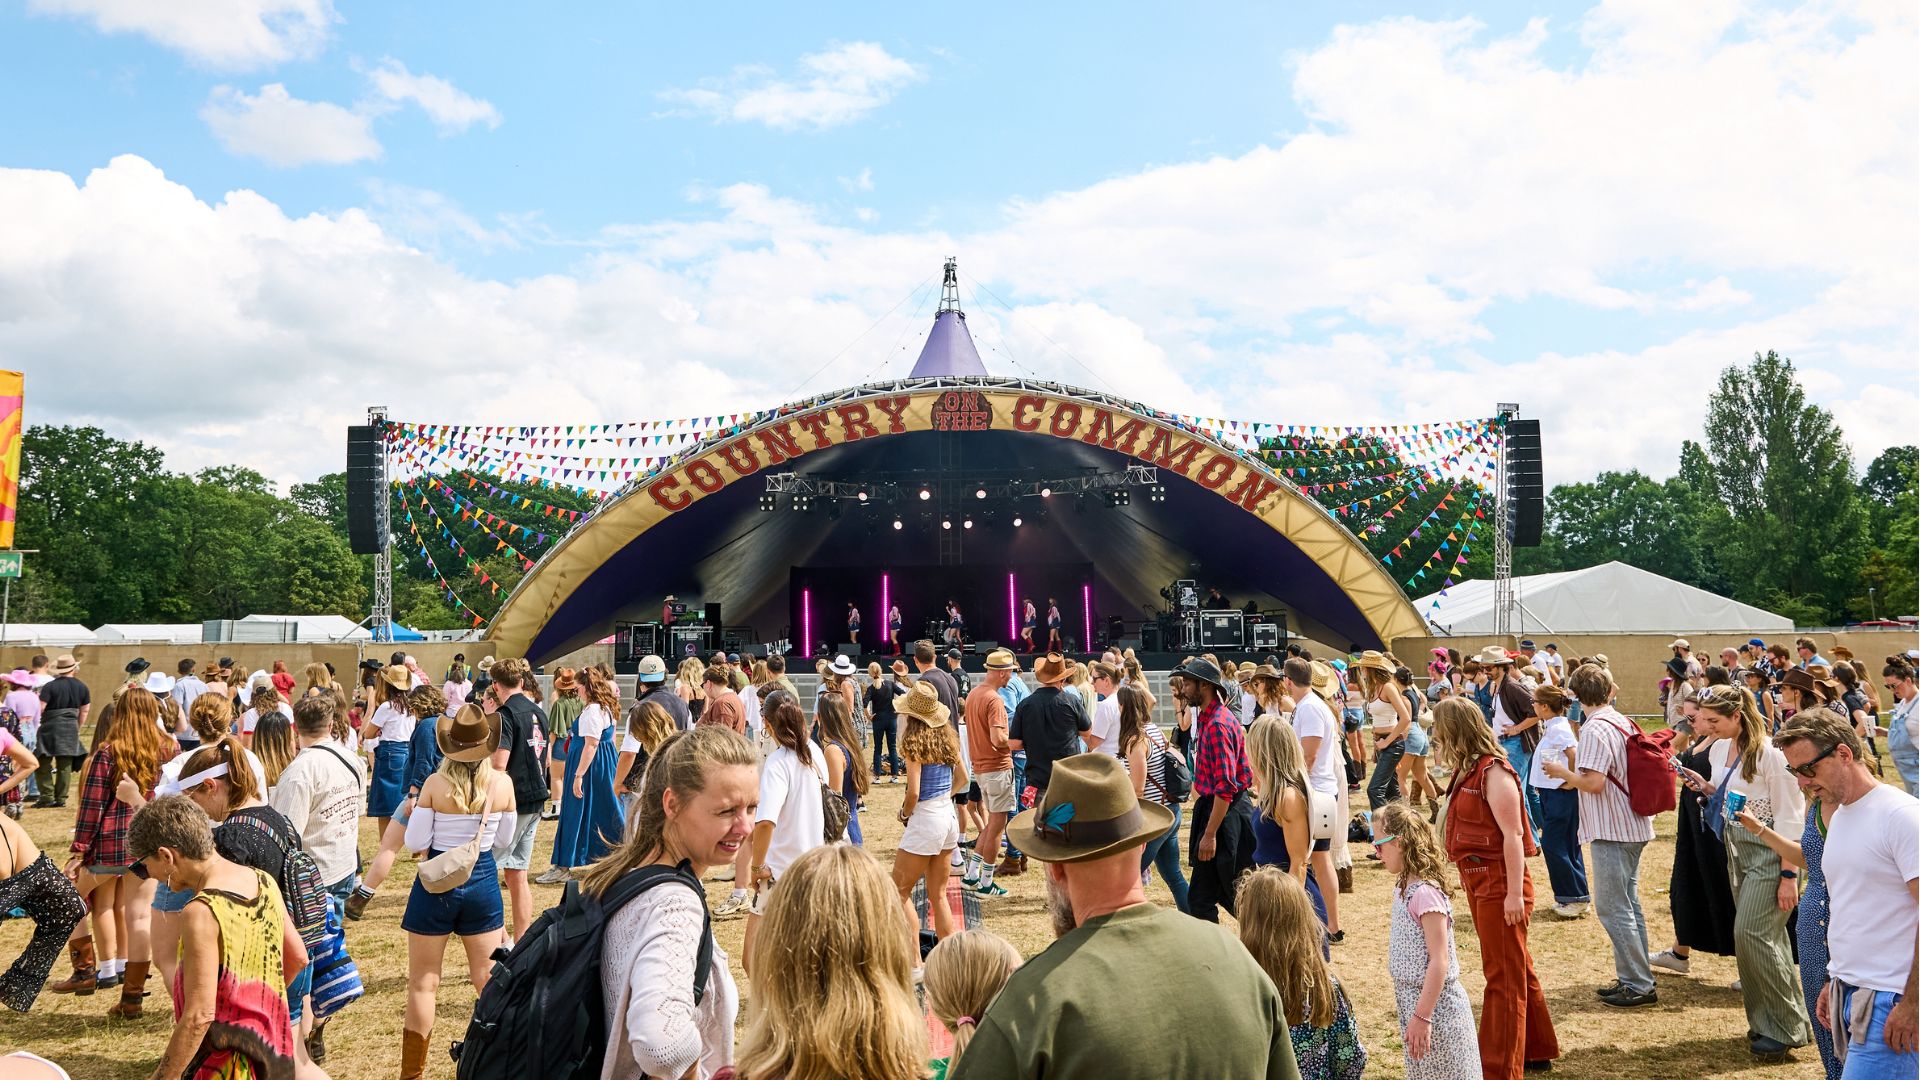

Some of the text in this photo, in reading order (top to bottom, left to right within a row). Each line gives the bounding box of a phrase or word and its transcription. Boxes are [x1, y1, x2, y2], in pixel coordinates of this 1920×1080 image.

[936, 411, 988, 431] THE
[944, 391, 979, 411] ON
[648, 396, 911, 512] COUNTRY
[1011, 395, 1280, 512] COMMON
